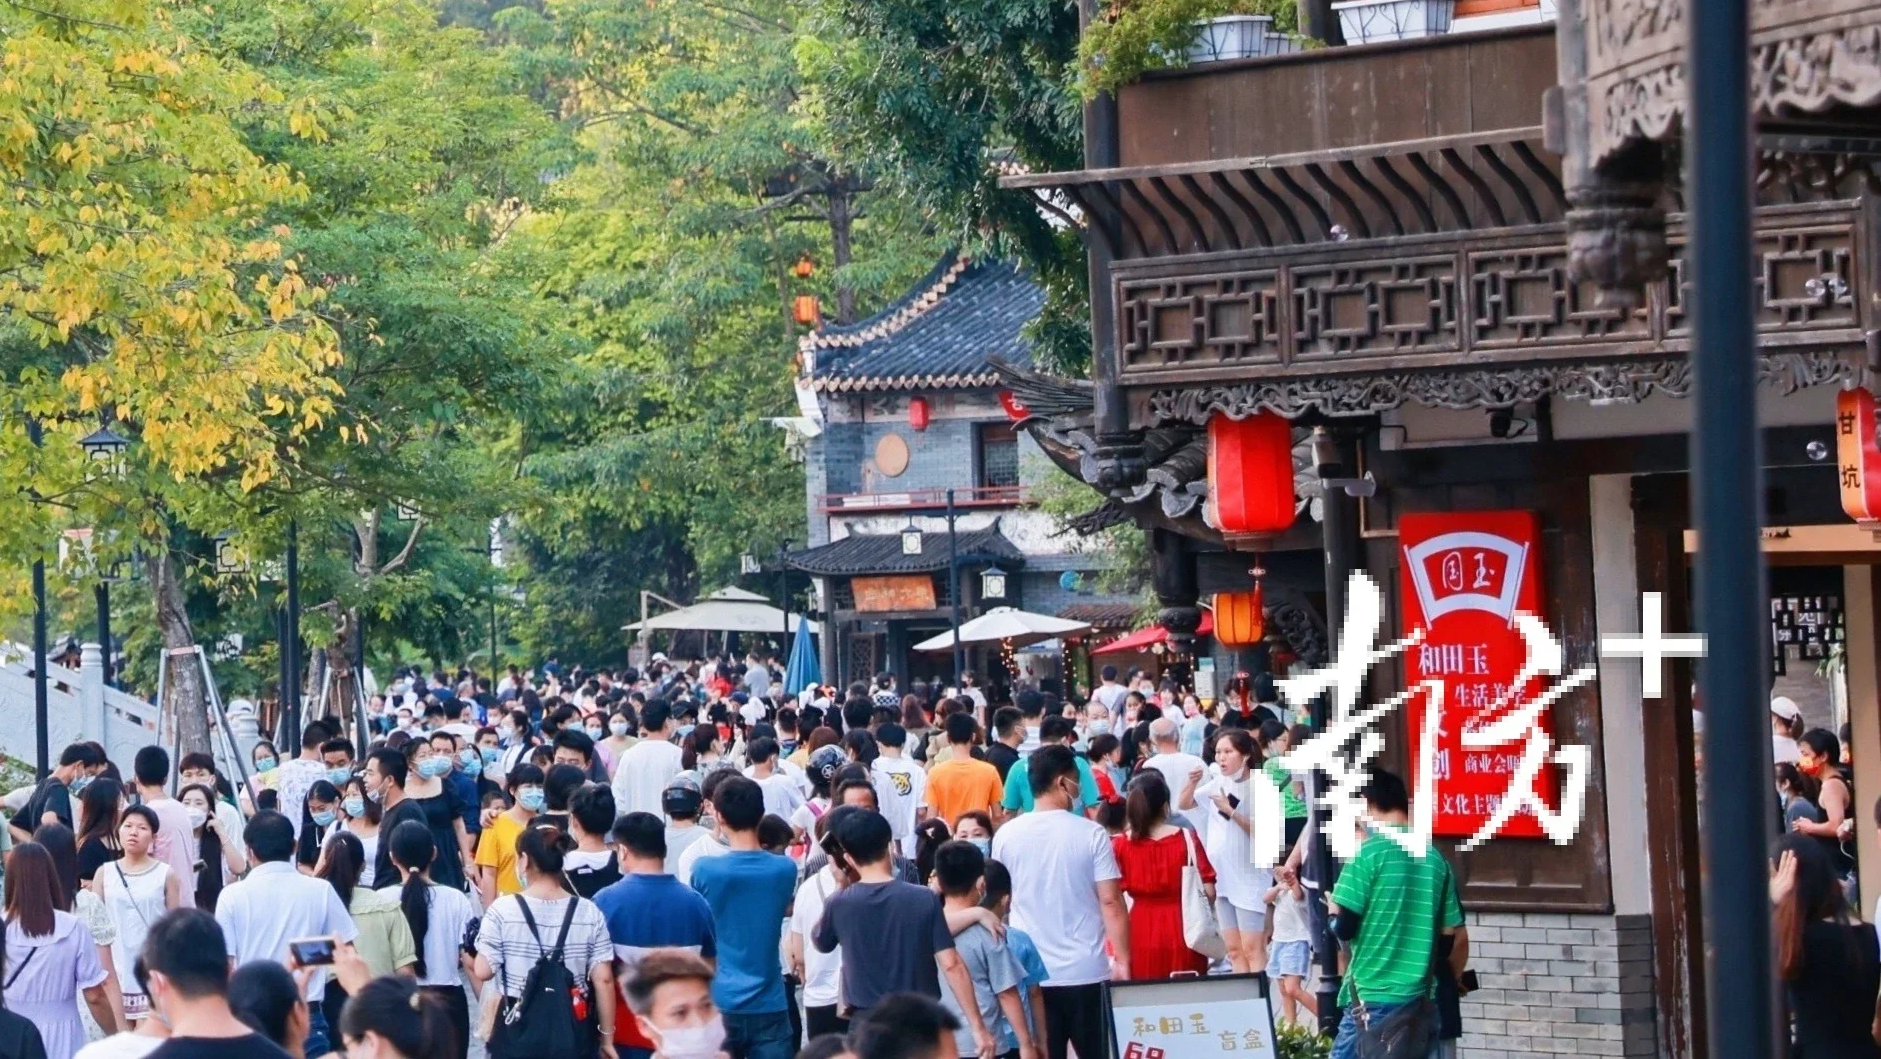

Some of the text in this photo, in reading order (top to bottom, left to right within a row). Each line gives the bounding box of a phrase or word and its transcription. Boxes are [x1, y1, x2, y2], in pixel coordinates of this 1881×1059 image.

[1838, 411, 1861, 489] 甘坑
[1419, 642, 1490, 676] 和田玉
[1132, 1012, 1265, 1051] 和田玉 盲盒
